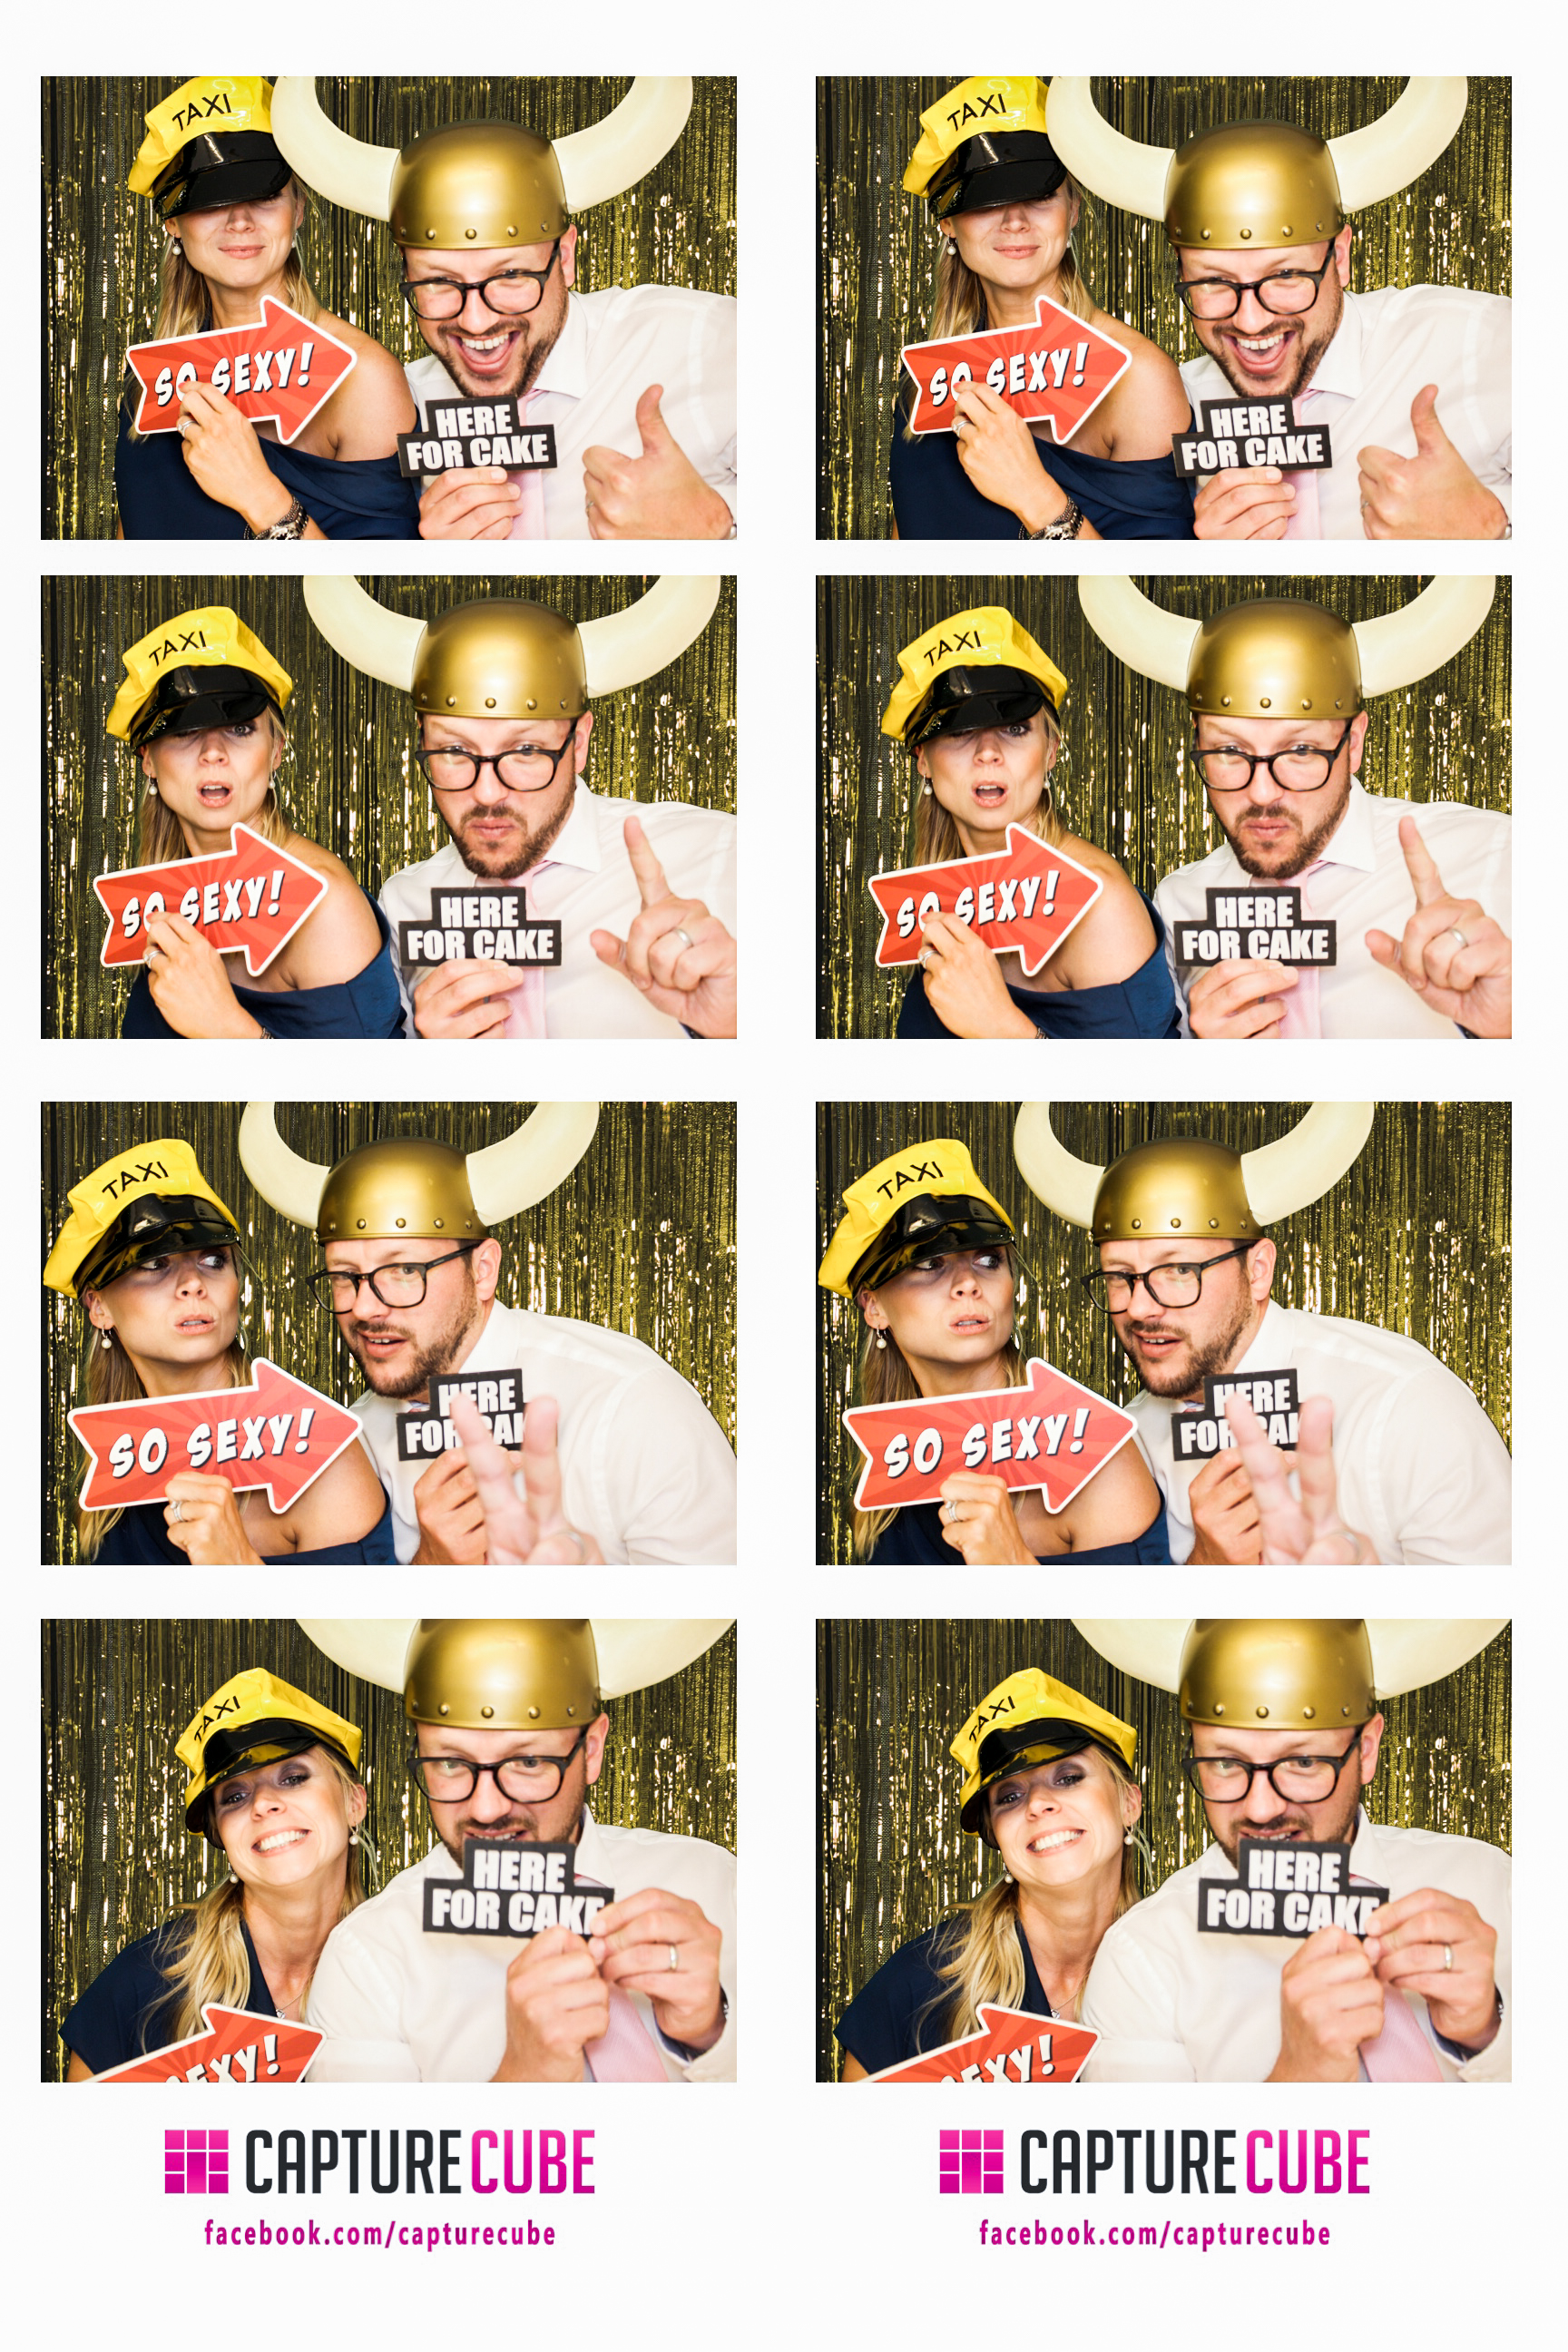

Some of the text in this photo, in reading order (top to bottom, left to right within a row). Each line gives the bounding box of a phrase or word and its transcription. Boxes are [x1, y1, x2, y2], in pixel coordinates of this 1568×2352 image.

[172, 93, 231, 132] TAXI
[947, 93, 1006, 132] TAXI
[211, 342, 314, 396] SEXY!
[985, 342, 1089, 396] SEXY!
[435, 404, 514, 438] HERE
[1210, 404, 1289, 438] HERE
[406, 434, 549, 471] FOR CAKE
[1181, 434, 1324, 471] FOR CAKE
[149, 631, 206, 667] TAXI
[924, 631, 981, 667] TAXI
[179, 870, 284, 926] SEXY!
[440, 896, 519, 928] HERE
[954, 870, 1059, 926] SEXY!
[1215, 896, 1294, 928] HERE
[407, 929, 554, 960] FOR CAKE
[1181, 929, 1329, 960] FOR CAKE
[102, 1161, 170, 1200] TAXI
[877, 1161, 945, 1200] TAXI
[109, 1407, 316, 1478] SO SEXY!
[884, 1407, 1091, 1478] SO SEXY!
[193, 1695, 241, 1743] TAXI
[968, 1695, 1016, 1743] TAXI
[473, 1848, 567, 1894] HERE
[1248, 1848, 1342, 1894] HERE
[431, 1887, 501, 1930] FOR
[1206, 1887, 1276, 1930] FOR
[165, 2034, 279, 2083] XY!
[940, 2034, 1054, 2083] XY!
